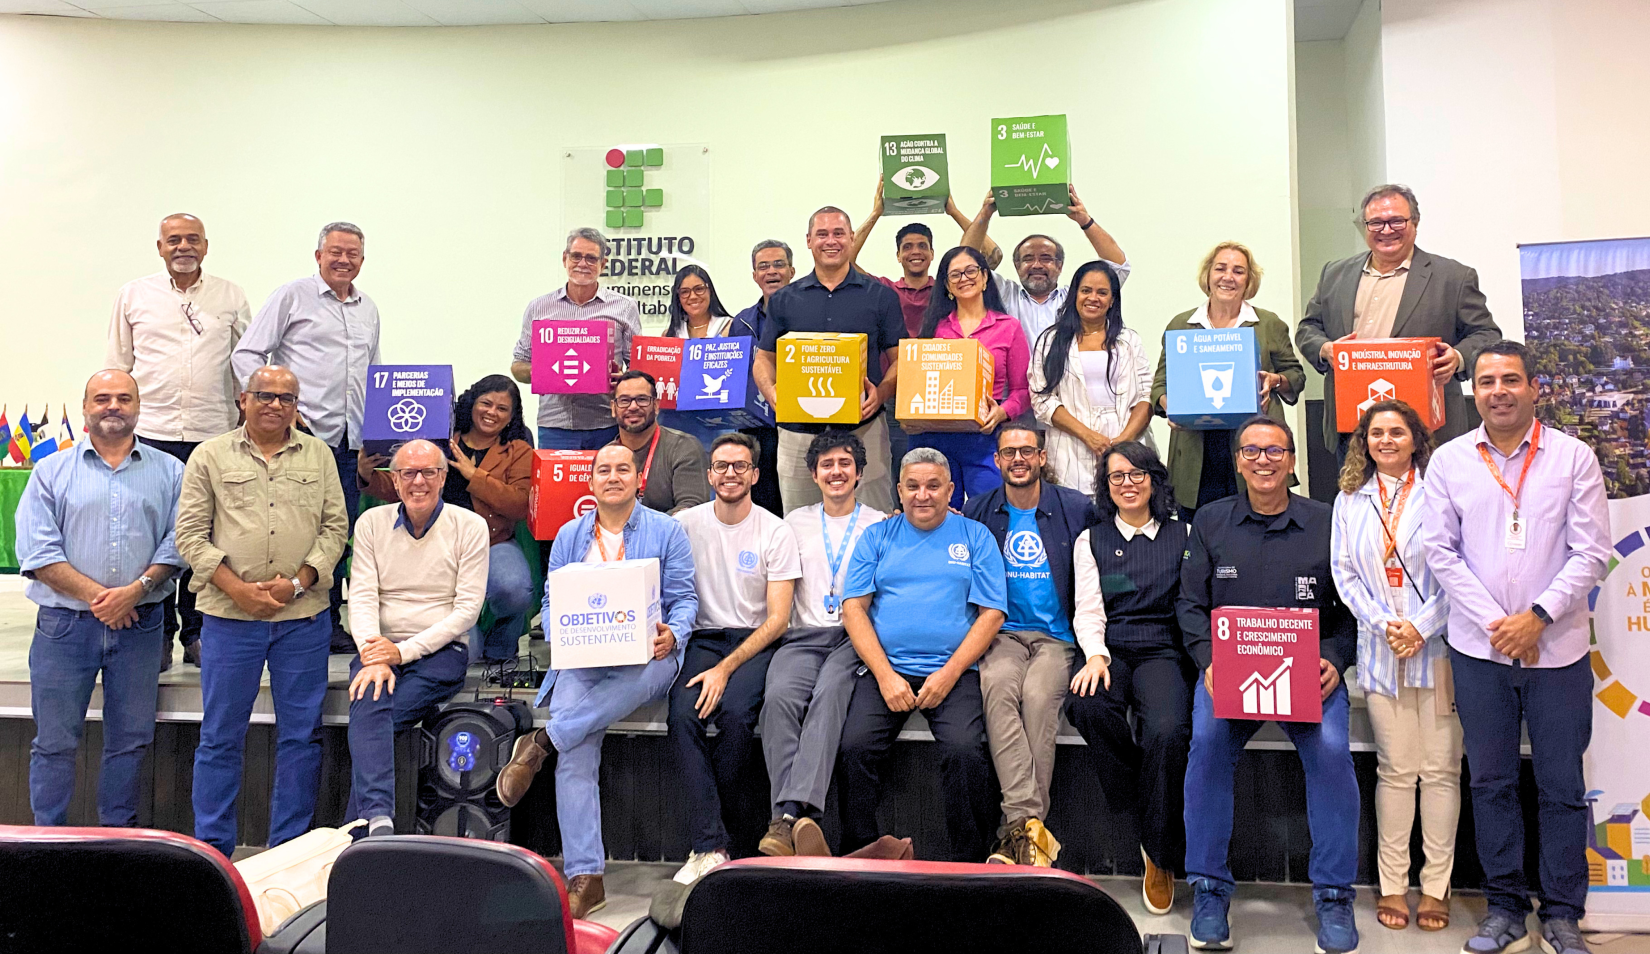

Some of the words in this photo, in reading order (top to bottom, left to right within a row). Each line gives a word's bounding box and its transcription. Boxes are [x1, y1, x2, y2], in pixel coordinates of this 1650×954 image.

[997, 124, 1007, 140] 3
[1012, 122, 1030, 131] SAÚDE
[1031, 122, 1036, 130] E
[1012, 131, 1045, 139] BEM-ESTAR
[884, 141, 898, 156] 13
[900, 140, 914, 148] AÇÃO
[914, 140, 934, 148] CONTRA
[599, 257, 681, 277] EDERAL
[539, 327, 554, 344] 10
[557, 327, 581, 335] REDUZIR
[580, 327, 588, 335] AS
[557, 336, 601, 344] DESIGUALDADES
[1193, 333, 1212, 343] ÁGUA
[1213, 332, 1242, 342] POTÁVEL
[647, 345, 682, 355] ERRADICAÇÃO
[718, 342, 740, 351] JUSTIÇA
[801, 345, 819, 353] FOME
[819, 345, 836, 353] ZERO
[922, 343, 947, 352] CIDADES
[947, 343, 951, 352] E
[1176, 335, 1187, 354] 6
[1193, 345, 1198, 353] E
[1199, 344, 1243, 353] SANEAMENTO
[636, 345, 642, 360] 1
[654, 354, 676, 362] POBREZA
[689, 344, 703, 361] 16
[704, 353, 709, 361] E
[785, 344, 796, 363] 2
[905, 343, 918, 362] 11
[921, 353, 963, 362] COMUNIDADES
[1351, 349, 1388, 360] INDÚSTRIA,
[1387, 349, 1421, 361] INOVAÇÃO
[703, 360, 728, 369] EFICAZES
[801, 355, 806, 363] E
[806, 355, 850, 364] AGRICULTURA
[1338, 351, 1350, 371] 9
[801, 364, 843, 374] SUSTENTÁVEL
[921, 361, 963, 371] SUSTENTÁVEIS
[1352, 362, 1357, 371] E
[1357, 361, 1413, 371] INFRAESTRUTURA
[373, 371, 389, 389] 17
[393, 371, 429, 380] PARCERIAS
[392, 380, 397, 388] E
[396, 380, 417, 388] MEIOS
[417, 380, 426, 388] DE
[391, 387, 444, 398] IMPLEMENTAÇÃO
[552, 463, 564, 482] 5
[569, 474, 577, 482] DE
[1006, 571, 1051, 579] NU-HABITAT
[1626, 582, 1637, 597] À
[559, 609, 636, 627] OBJETIVOS
[1236, 617, 1278, 629] TRABALHO
[1279, 619, 1313, 630] DECENTE
[560, 627, 569, 635] DE
[570, 622, 637, 635] DESENVOLVIMENTO
[1217, 616, 1230, 641] 8
[560, 631, 637, 647] SUSTENTÁVEL
[1236, 631, 1242, 641] E
[1243, 631, 1298, 643] CRESCIMENTO
[1237, 643, 1284, 656] ECONÔMICO
